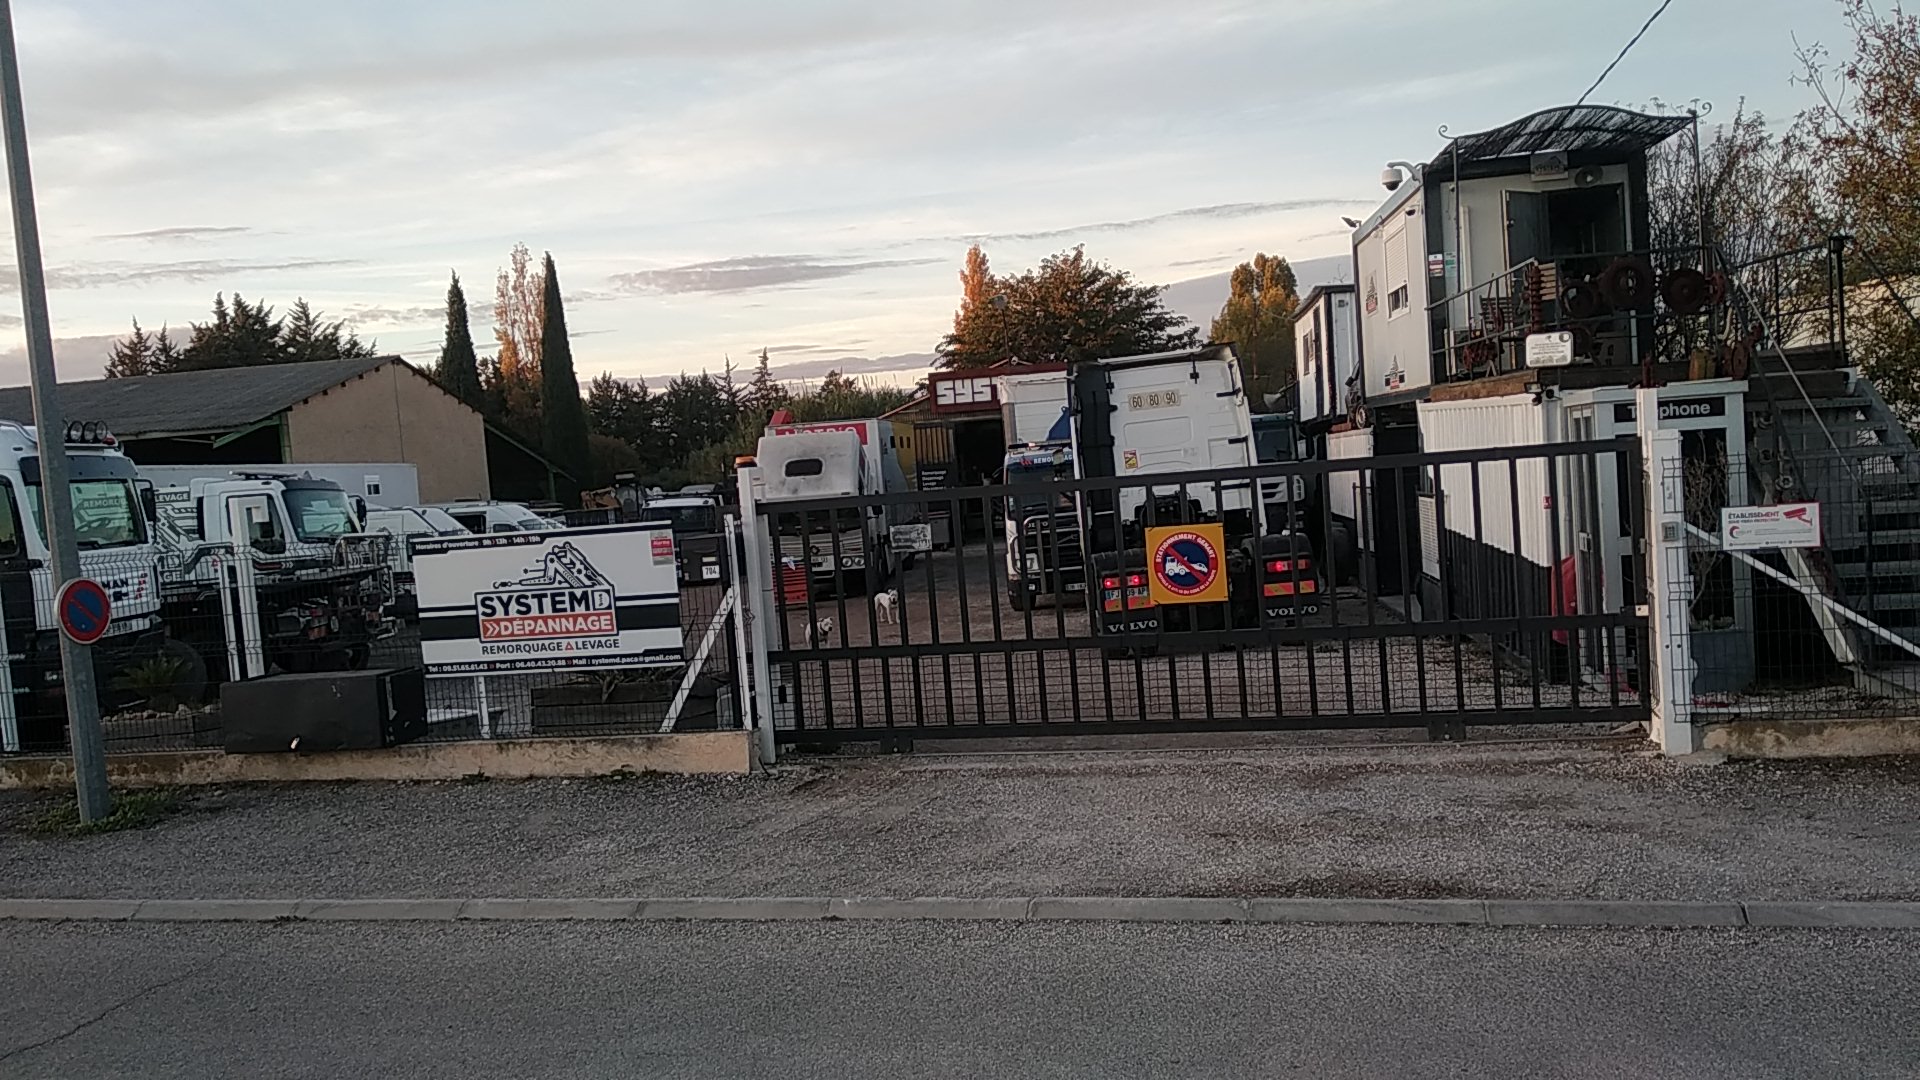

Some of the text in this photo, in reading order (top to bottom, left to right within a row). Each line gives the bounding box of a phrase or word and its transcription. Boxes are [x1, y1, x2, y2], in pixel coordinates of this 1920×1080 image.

[1132, 392, 1176, 407] 60 80 90
[1627, 403, 1711, 419] Tphone
[415, 542, 441, 550] Horaires
[1156, 533, 1197, 563] STATIONNEMENT
[500, 615, 613, 636] DÉPANNAGE
[481, 638, 620, 655] REMORQUAGE LEVAGE
